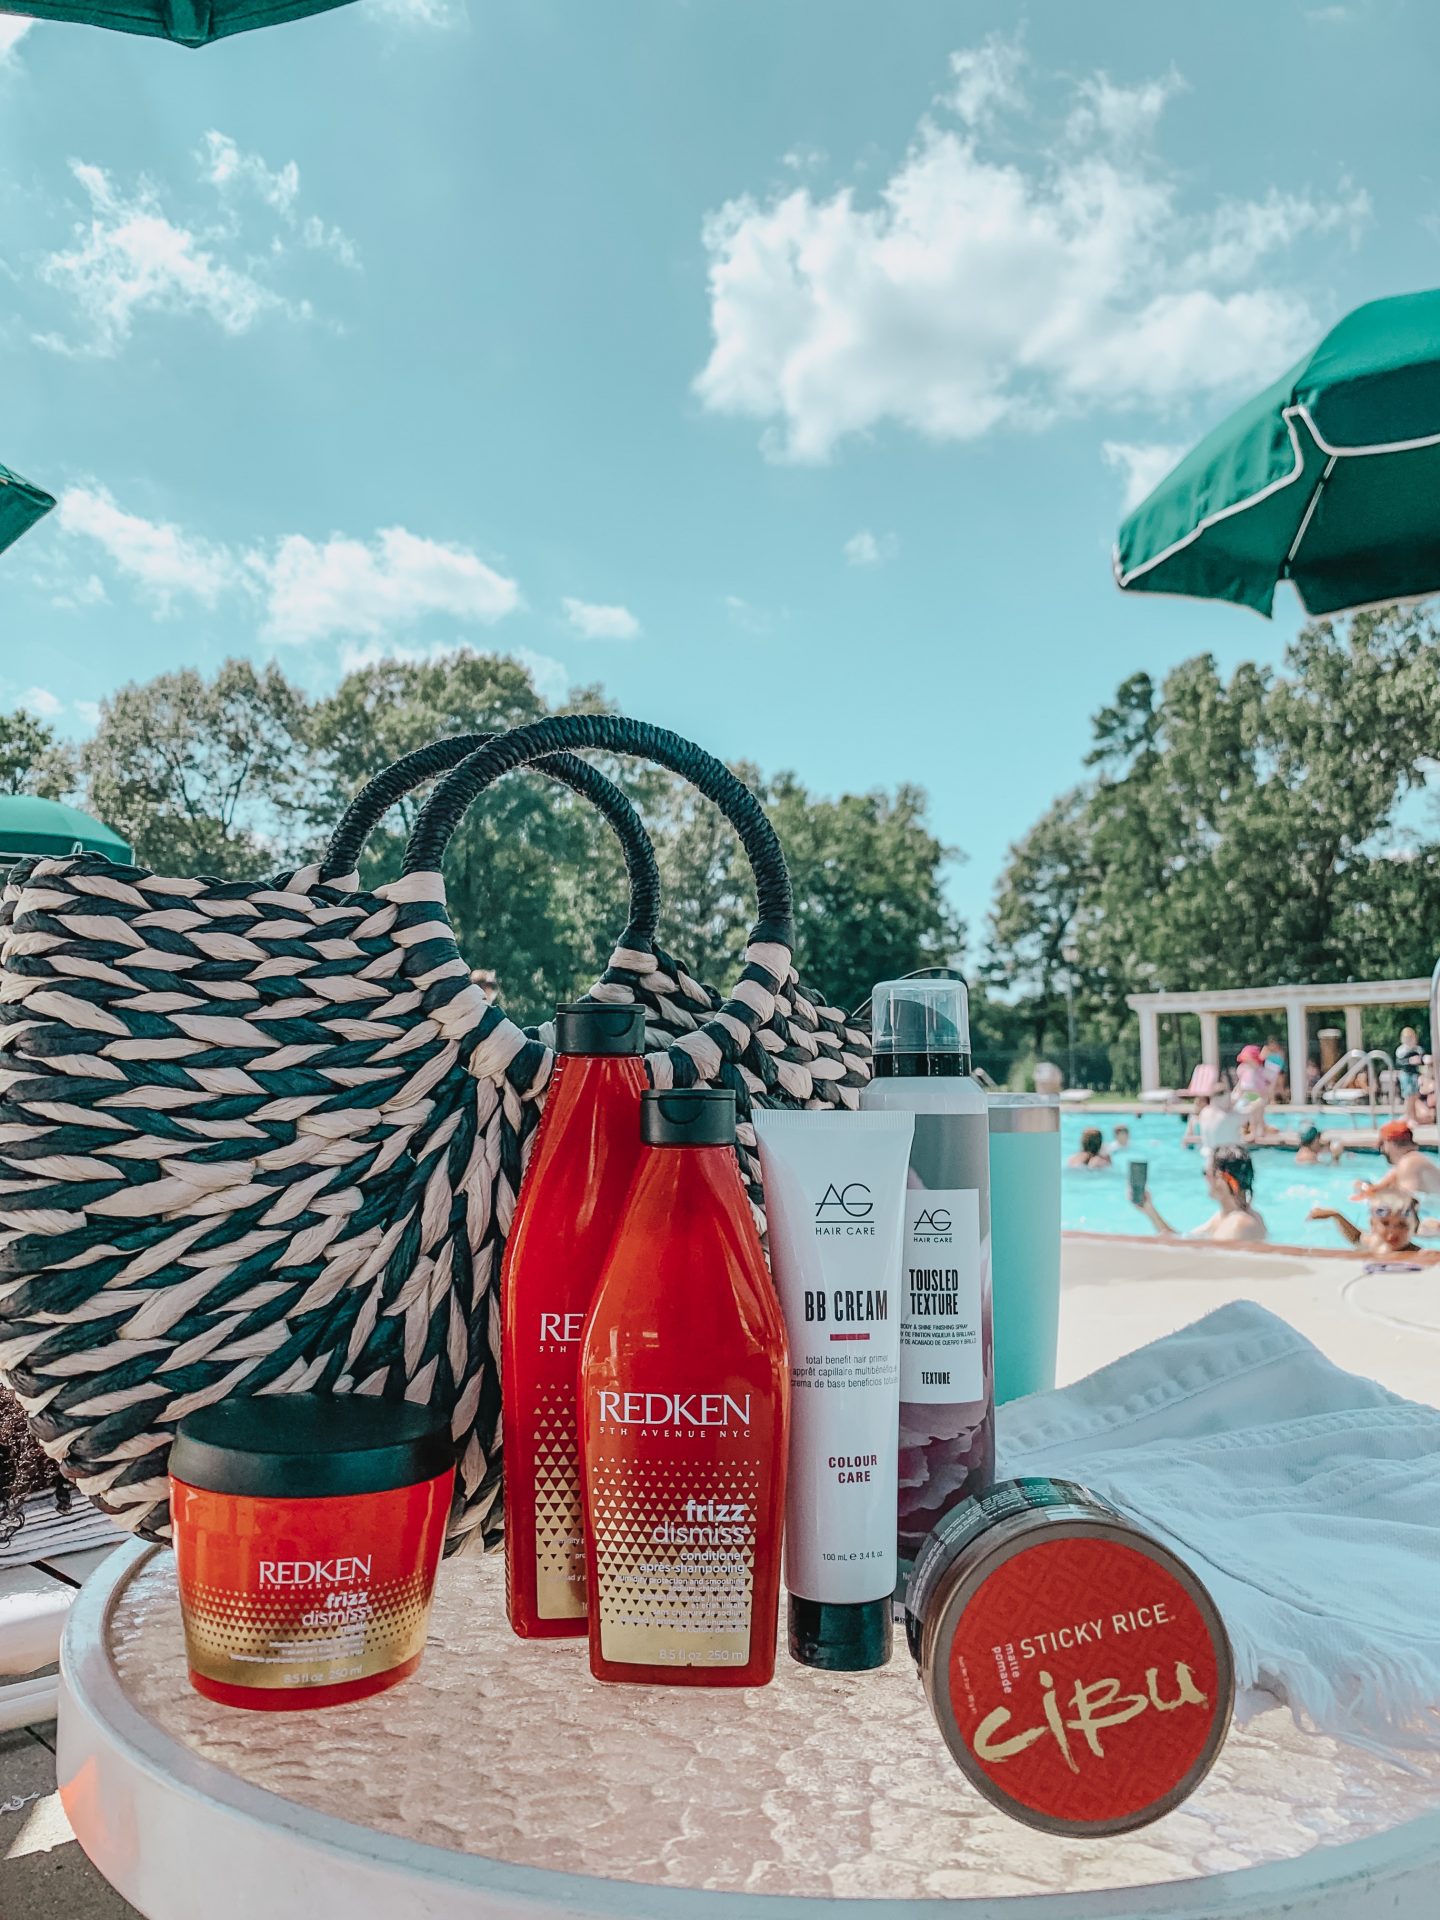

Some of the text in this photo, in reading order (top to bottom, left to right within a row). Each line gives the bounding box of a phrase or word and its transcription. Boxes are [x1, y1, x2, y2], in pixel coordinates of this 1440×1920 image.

[815, 1183, 873, 1217] AG
[913, 1209, 952, 1231] AG
[815, 1227, 875, 1235] HAIR CARE
[909, 1269, 959, 1291] TOUSLED
[804, 1290, 888, 1322] BB CREAM
[910, 1293, 959, 1316] TEXTURE
[805, 1355, 823, 1364] total
[825, 1355, 851, 1364] benefit
[792, 1367, 816, 1377] apprêt
[818, 1367, 853, 1377] capillaire
[921, 1372, 951, 1385] TEXTURE
[814, 1379, 824, 1388] de
[827, 1379, 846, 1388] base
[599, 1391, 750, 1426] REDKEN
[600, 1426, 750, 1438] 5TH AVENUE NYC
[828, 1454, 878, 1468] COLOUR
[838, 1470, 871, 1483] CARE
[685, 1499, 745, 1521] frizz
[653, 1521, 745, 1545] dismiss
[680, 1550, 744, 1561] conditioner
[822, 1552, 836, 1561] 100
[859, 1551, 869, 1560] 3.4
[259, 1554, 372, 1585] REDKEN
[640, 1562, 745, 1575] après-shampooing
[290, 1582, 339, 1590] AVENUE
[348, 1577, 370, 1585] NYC
[326, 1591, 369, 1609] frizz
[302, 1605, 366, 1627] dismiss
[1020, 1603, 1169, 1659] STICKY RICE
[709, 1650, 729, 1660] 250
[1005, 1643, 1020, 1678] matte
[992, 1646, 1012, 1694] pomade
